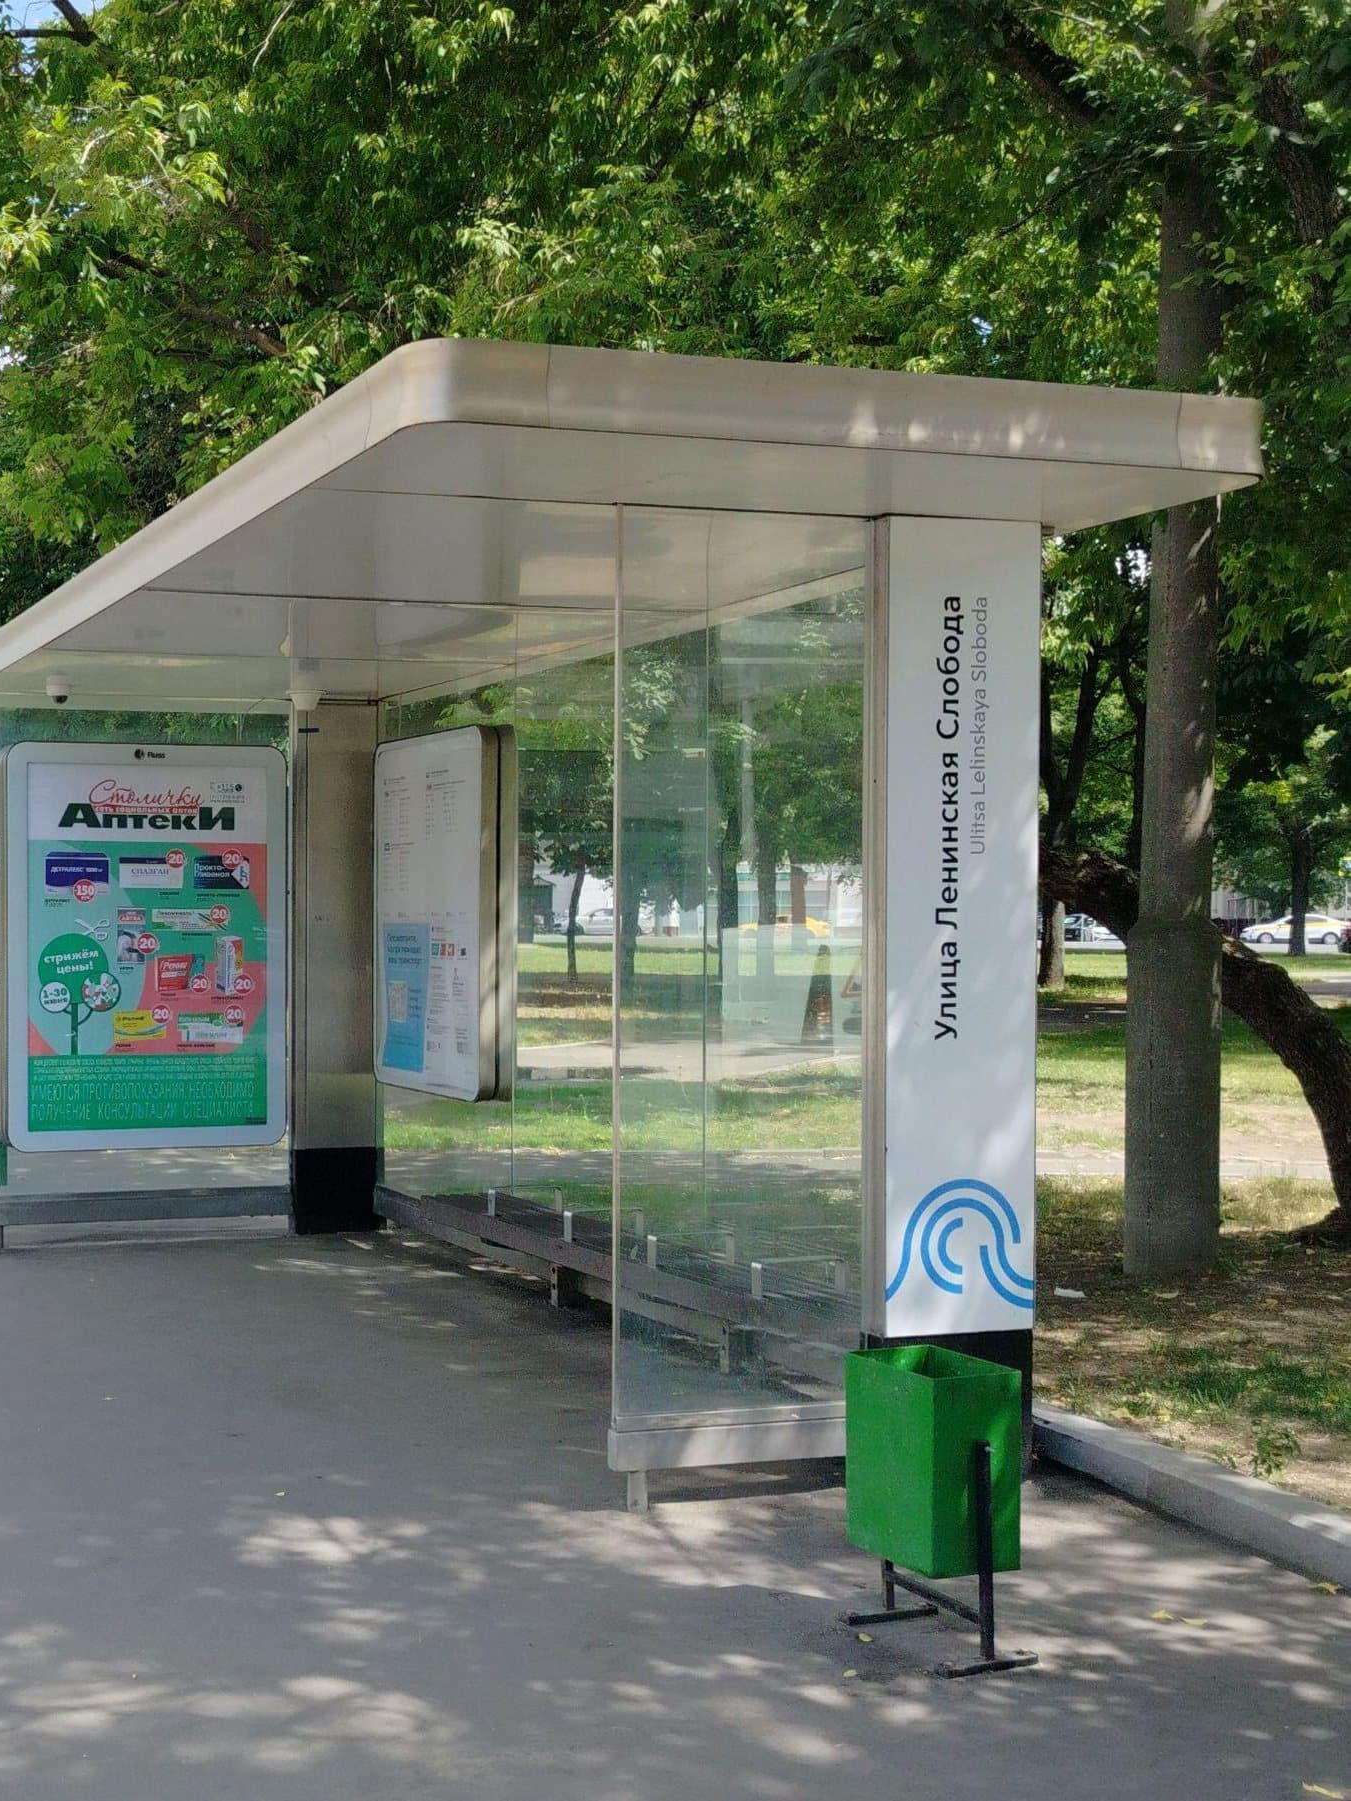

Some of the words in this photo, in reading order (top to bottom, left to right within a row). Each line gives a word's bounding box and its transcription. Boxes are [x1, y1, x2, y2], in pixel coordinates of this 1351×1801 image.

[970, 596, 988, 682] Sloboda
[935, 596, 965, 740] Слобода
[969, 688, 990, 795] Lelinskaya
[88, 779, 205, 806] Столички
[969, 801, 986, 855] Ulitsa
[934, 752, 959, 930] Ленинская
[168, 853, 184, 864] 20
[225, 853, 240, 864] 20
[212, 909, 227, 919] 20
[138, 938, 156, 949] 20
[43, 949, 99, 965] стрижём
[56, 961, 94, 975] цены!
[192, 979, 207, 989] 20
[235, 979, 251, 990] 20
[934, 941, 960, 1041] Улица
[43, 987, 68, 998] 1-30
[152, 1009, 169, 1020] 20
[226, 1010, 241, 1020] 20
[31, 1082, 80, 1101] ИМЕЮТСЯ
[188, 1080, 254, 1098] НЕОБХОДИМО
[31, 1103, 91, 1120] ПОЛУЧЕНИЕ
[98, 1102, 176, 1120] КОНСУЛЬТАЦИИ
[183, 1100, 253, 1120] СПЕЦИАЛИСТА
